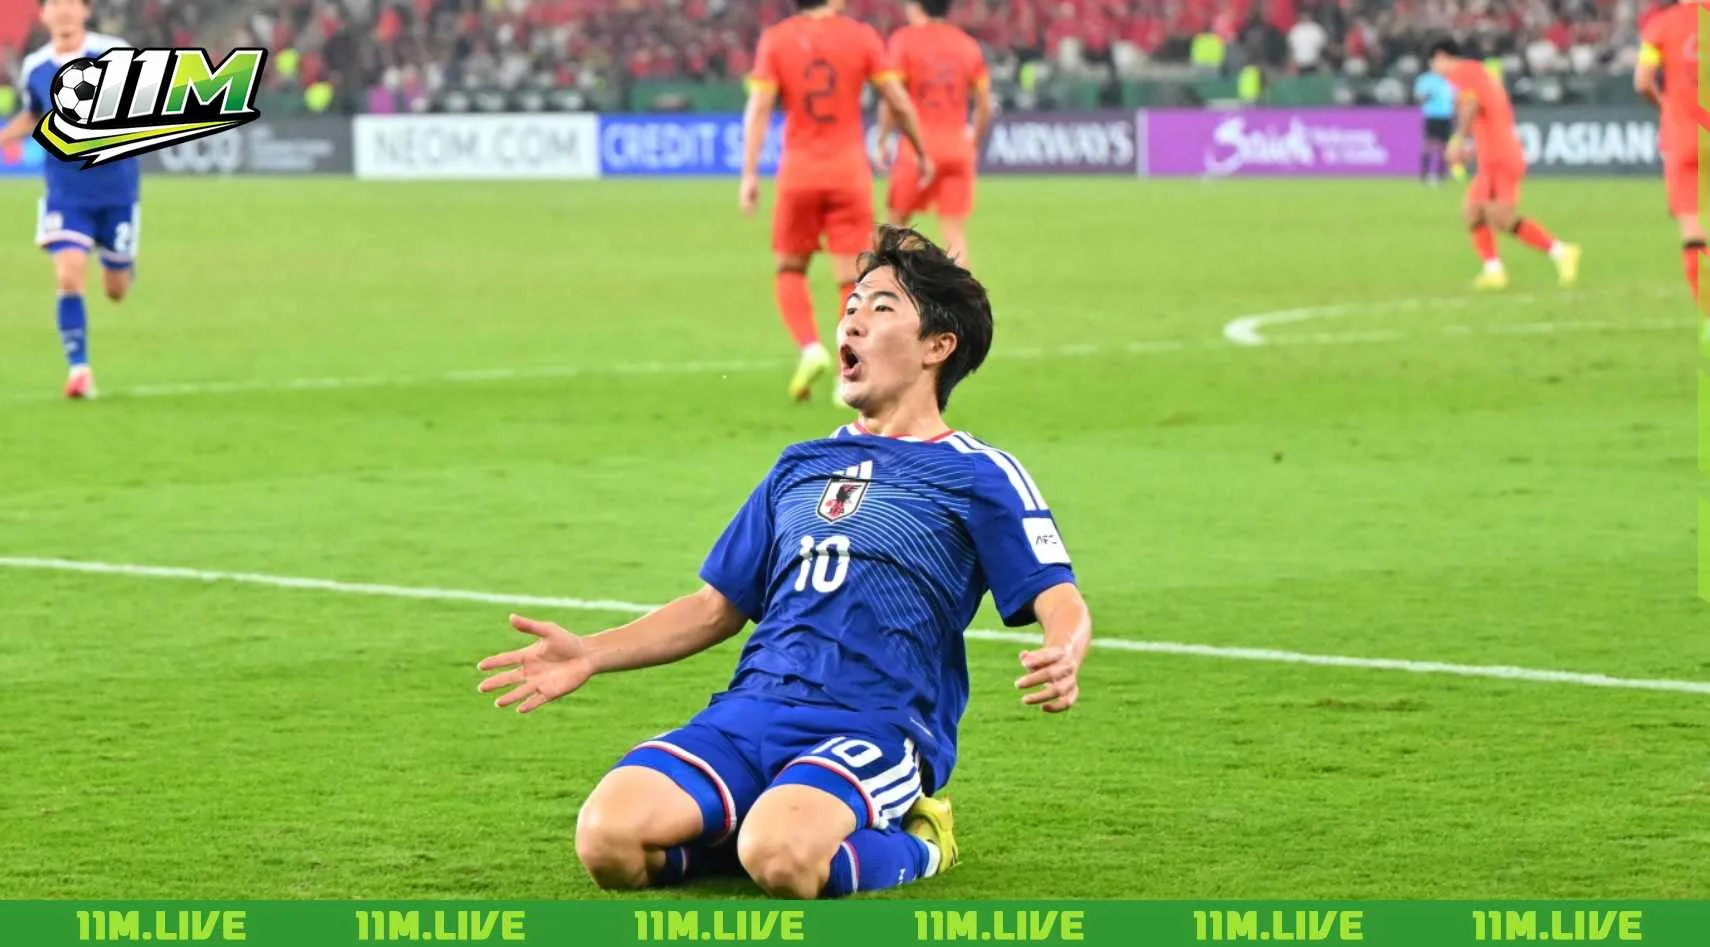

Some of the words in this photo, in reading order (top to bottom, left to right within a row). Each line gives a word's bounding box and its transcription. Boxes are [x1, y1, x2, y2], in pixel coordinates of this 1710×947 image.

[803, 57, 838, 124] 2
[603, 122, 719, 167] CREDIT
[987, 121, 1134, 166] AIRWAYS
[1545, 122, 1656, 165] ASIAN
[794, 535, 851, 592] 10
[812, 736, 884, 769] 10
